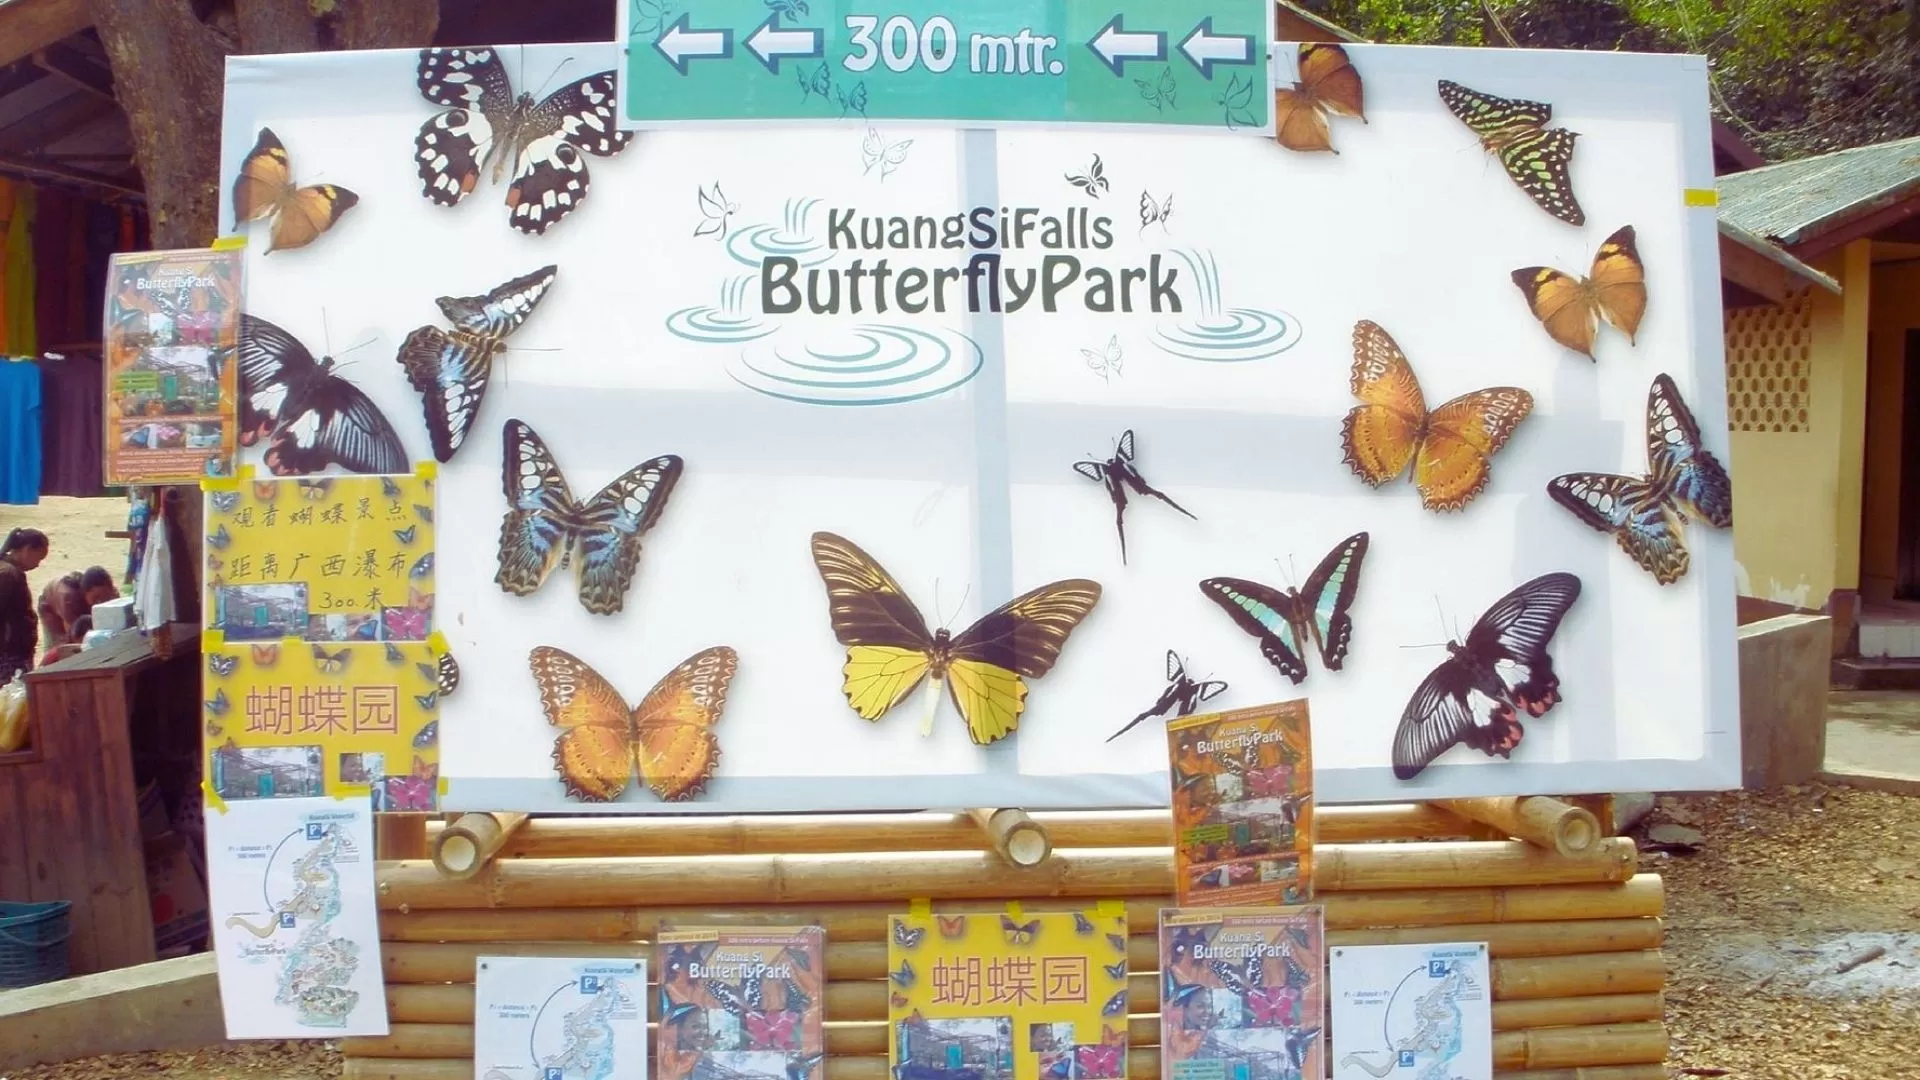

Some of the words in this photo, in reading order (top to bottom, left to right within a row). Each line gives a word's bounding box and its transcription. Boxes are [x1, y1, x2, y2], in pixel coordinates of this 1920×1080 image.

[842, 14, 957, 74] 300
[969, 29, 1066, 77] mtr.
[827, 207, 1114, 251] KuangSiFalls
[136, 275, 215, 290] ButterflyPark
[760, 253, 1183, 315] ButterflyPark
[245, 685, 399, 736] 蝴蝶园
[1197, 729, 1284, 754] ButterflyPark
[689, 962, 792, 979] ButterflyPark
[1193, 940, 1292, 959] ButterflyPark
[931, 956, 1088, 1007] 蝴蝶园
